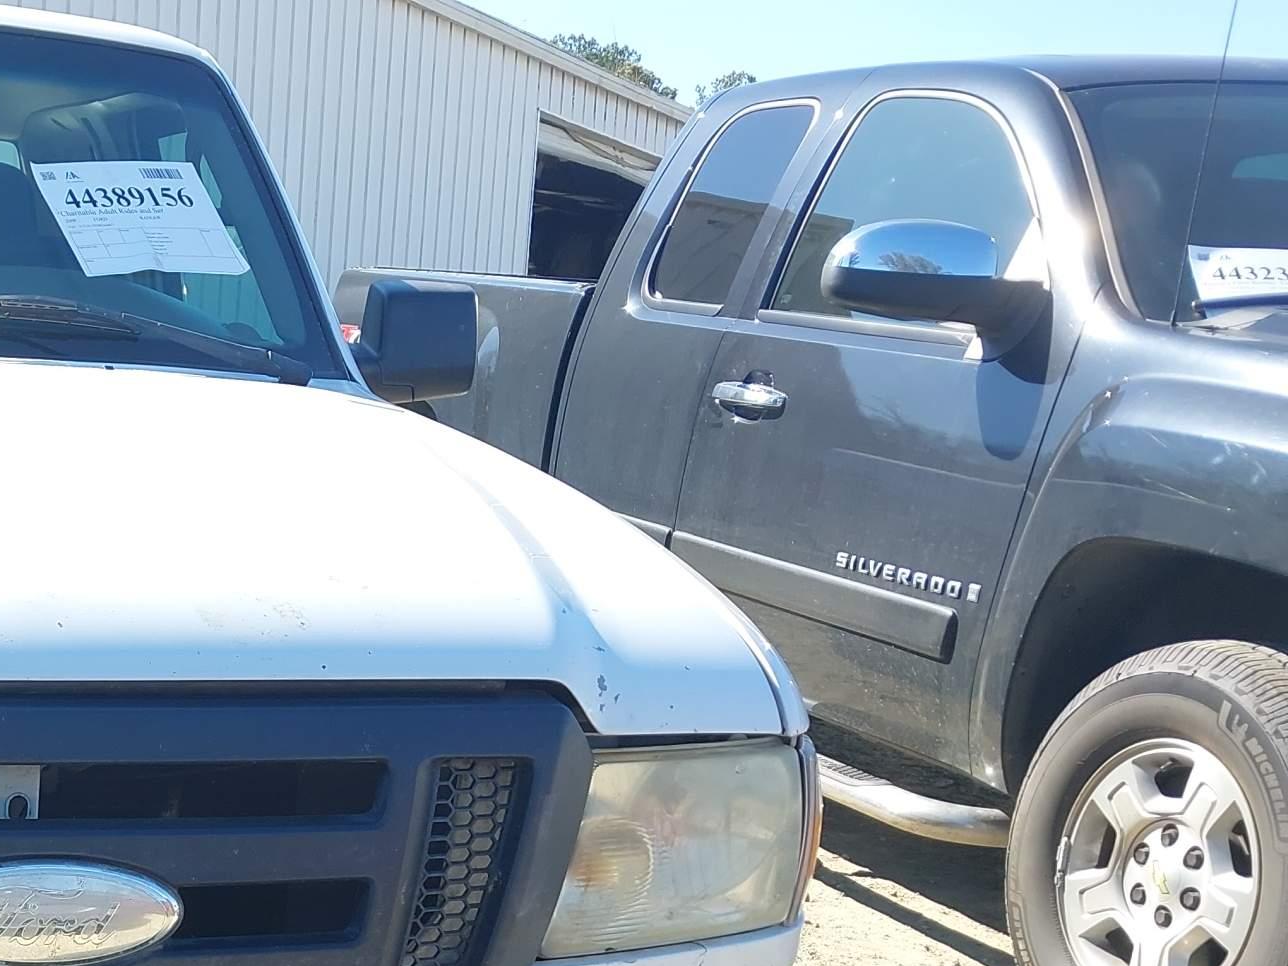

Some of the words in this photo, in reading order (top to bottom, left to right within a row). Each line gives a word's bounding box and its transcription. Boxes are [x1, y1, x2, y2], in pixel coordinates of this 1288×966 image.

[64, 186, 194, 208] 44389156
[1212, 266, 1288, 281] 44323
[836, 551, 962, 599] SILVERADO
